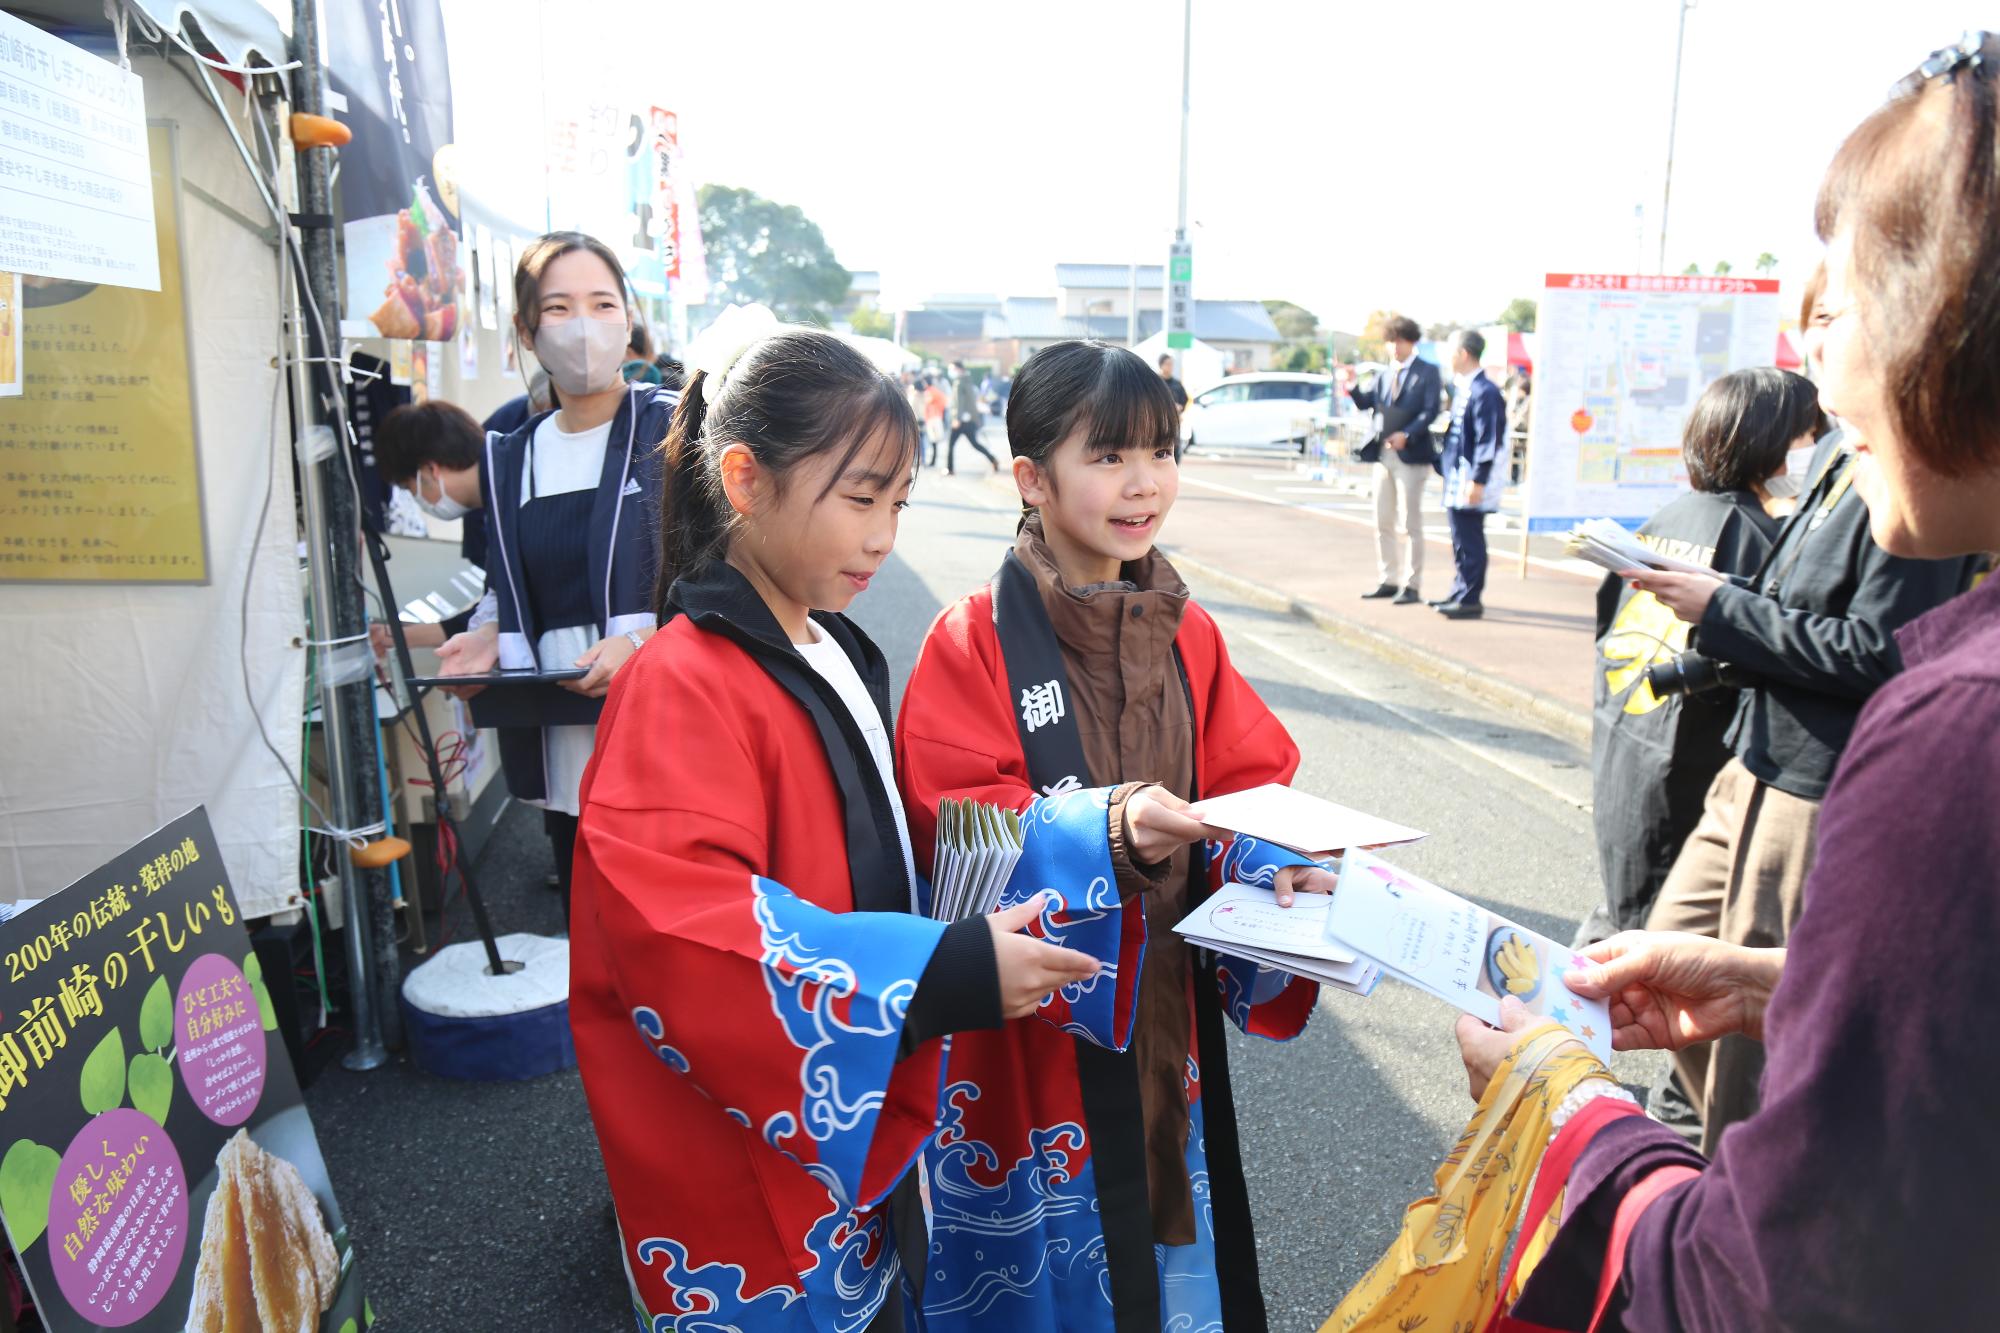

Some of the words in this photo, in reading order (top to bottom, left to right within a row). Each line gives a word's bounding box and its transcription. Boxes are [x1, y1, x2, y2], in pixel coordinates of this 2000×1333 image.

[0, 440, 136, 453] 崎に受け継がれています。
[0, 551, 199, 567] 前崎から、新たな物語がはじまります。
[4, 836, 201, 984] 200年の伝統・発祥の地
[0, 884, 235, 1113] 御前崎の干しいも
[182, 974, 243, 1015] ひと工夫で
[186, 1000, 248, 1042] 自分好みに
[63, 1135, 149, 1262] 自然な味わい
[69, 1139, 117, 1206] 優しく
